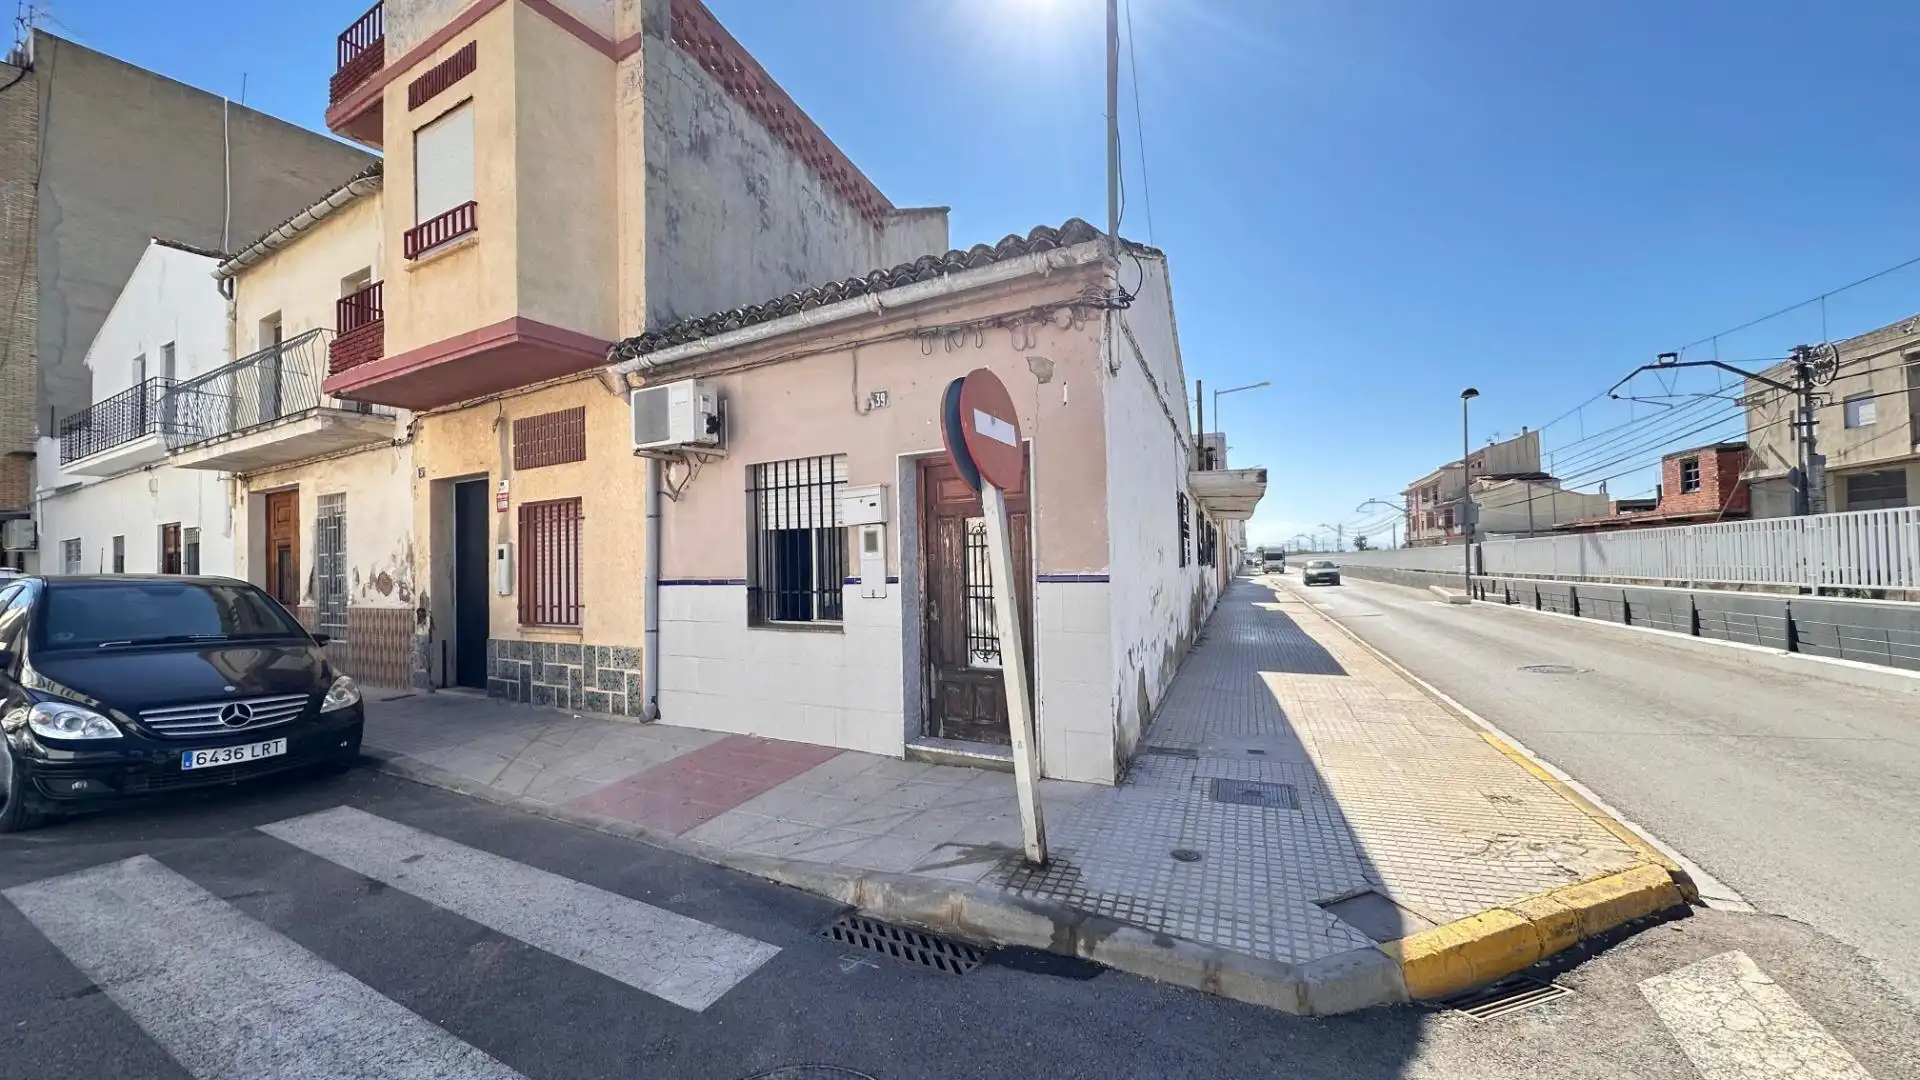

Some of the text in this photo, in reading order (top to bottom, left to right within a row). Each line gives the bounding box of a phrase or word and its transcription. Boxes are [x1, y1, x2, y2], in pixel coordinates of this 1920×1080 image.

[875, 392, 886, 407] 39
[196, 740, 282, 766] 6436 LRT
